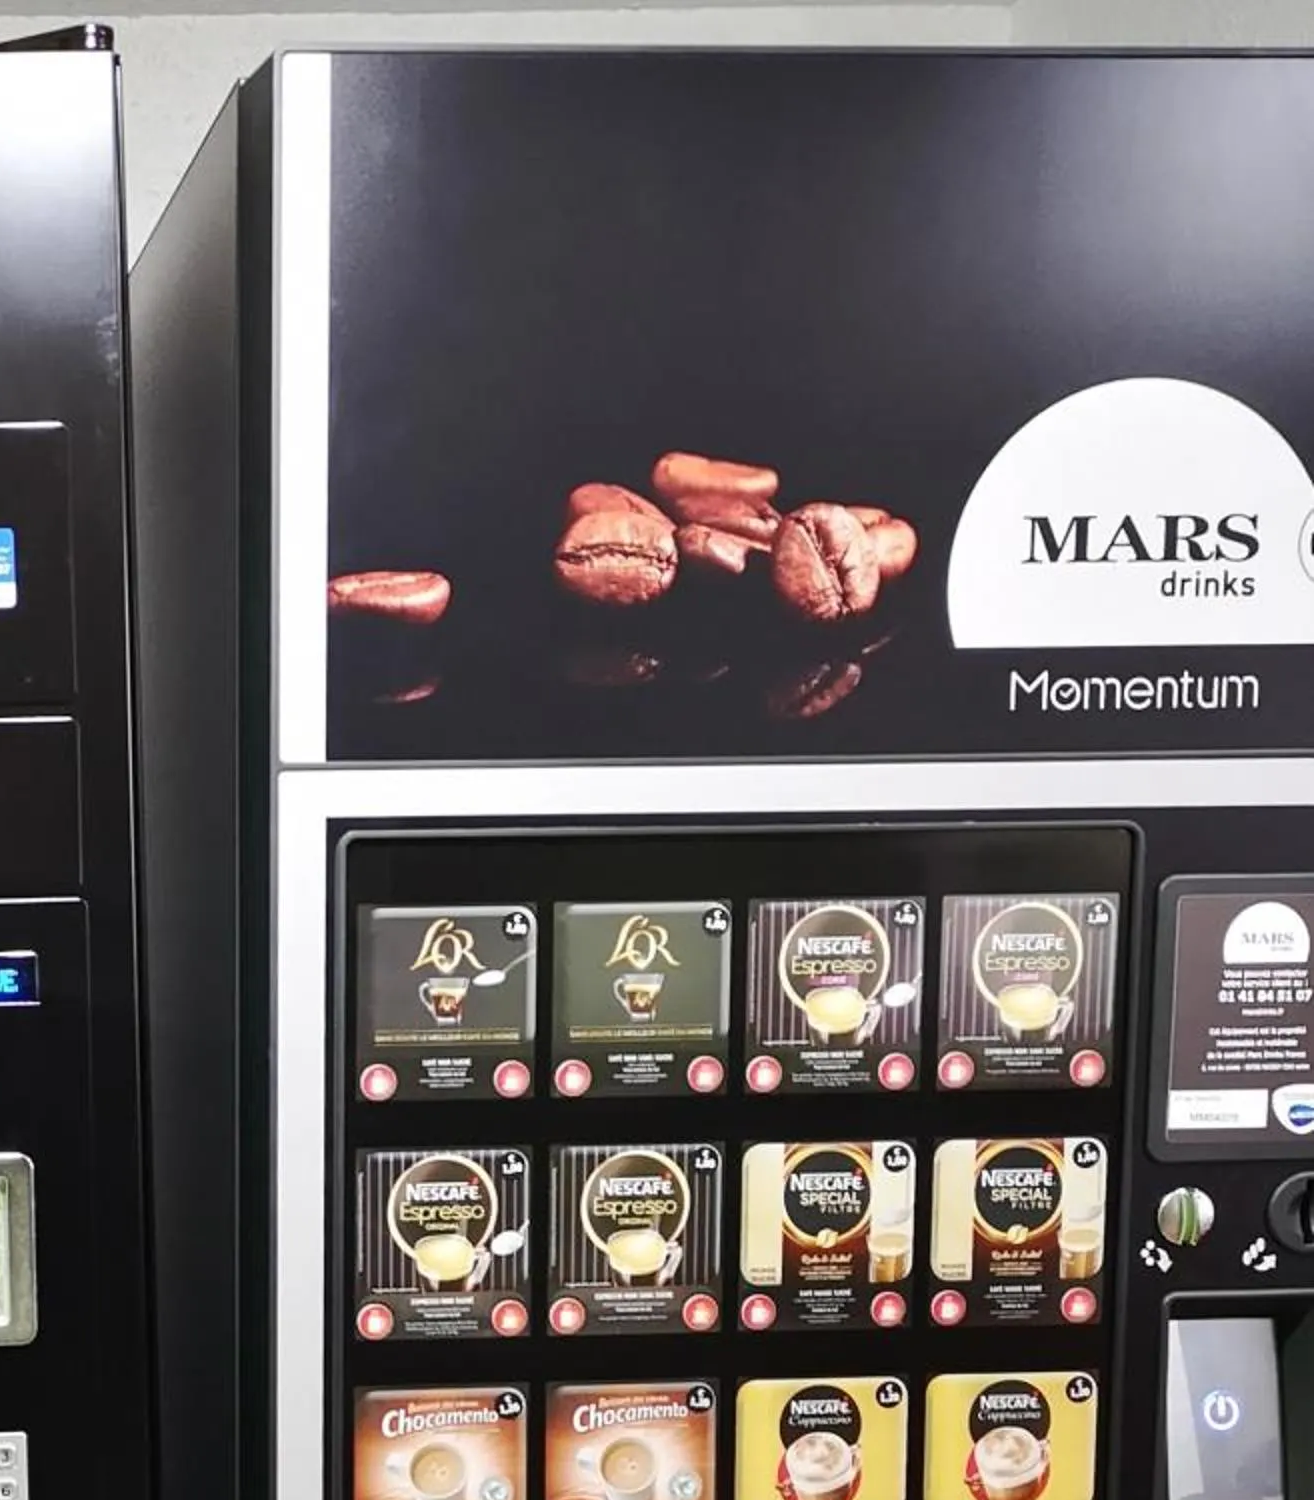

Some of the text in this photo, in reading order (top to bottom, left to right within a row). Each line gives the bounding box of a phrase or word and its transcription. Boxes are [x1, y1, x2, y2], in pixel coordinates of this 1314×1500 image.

[1021, 514, 1260, 564] MARS
[1161, 570, 1255, 598] drinks
[1009, 670, 1260, 712] Momentum
[792, 956, 877, 978] Espresso
[985, 953, 1070, 975] Espresso
[399, 1202, 485, 1225] Espresso
[593, 1197, 677, 1220] Espresso
[382, 1406, 499, 1438] Chocamento
[573, 1401, 687, 1433] Chocamento
